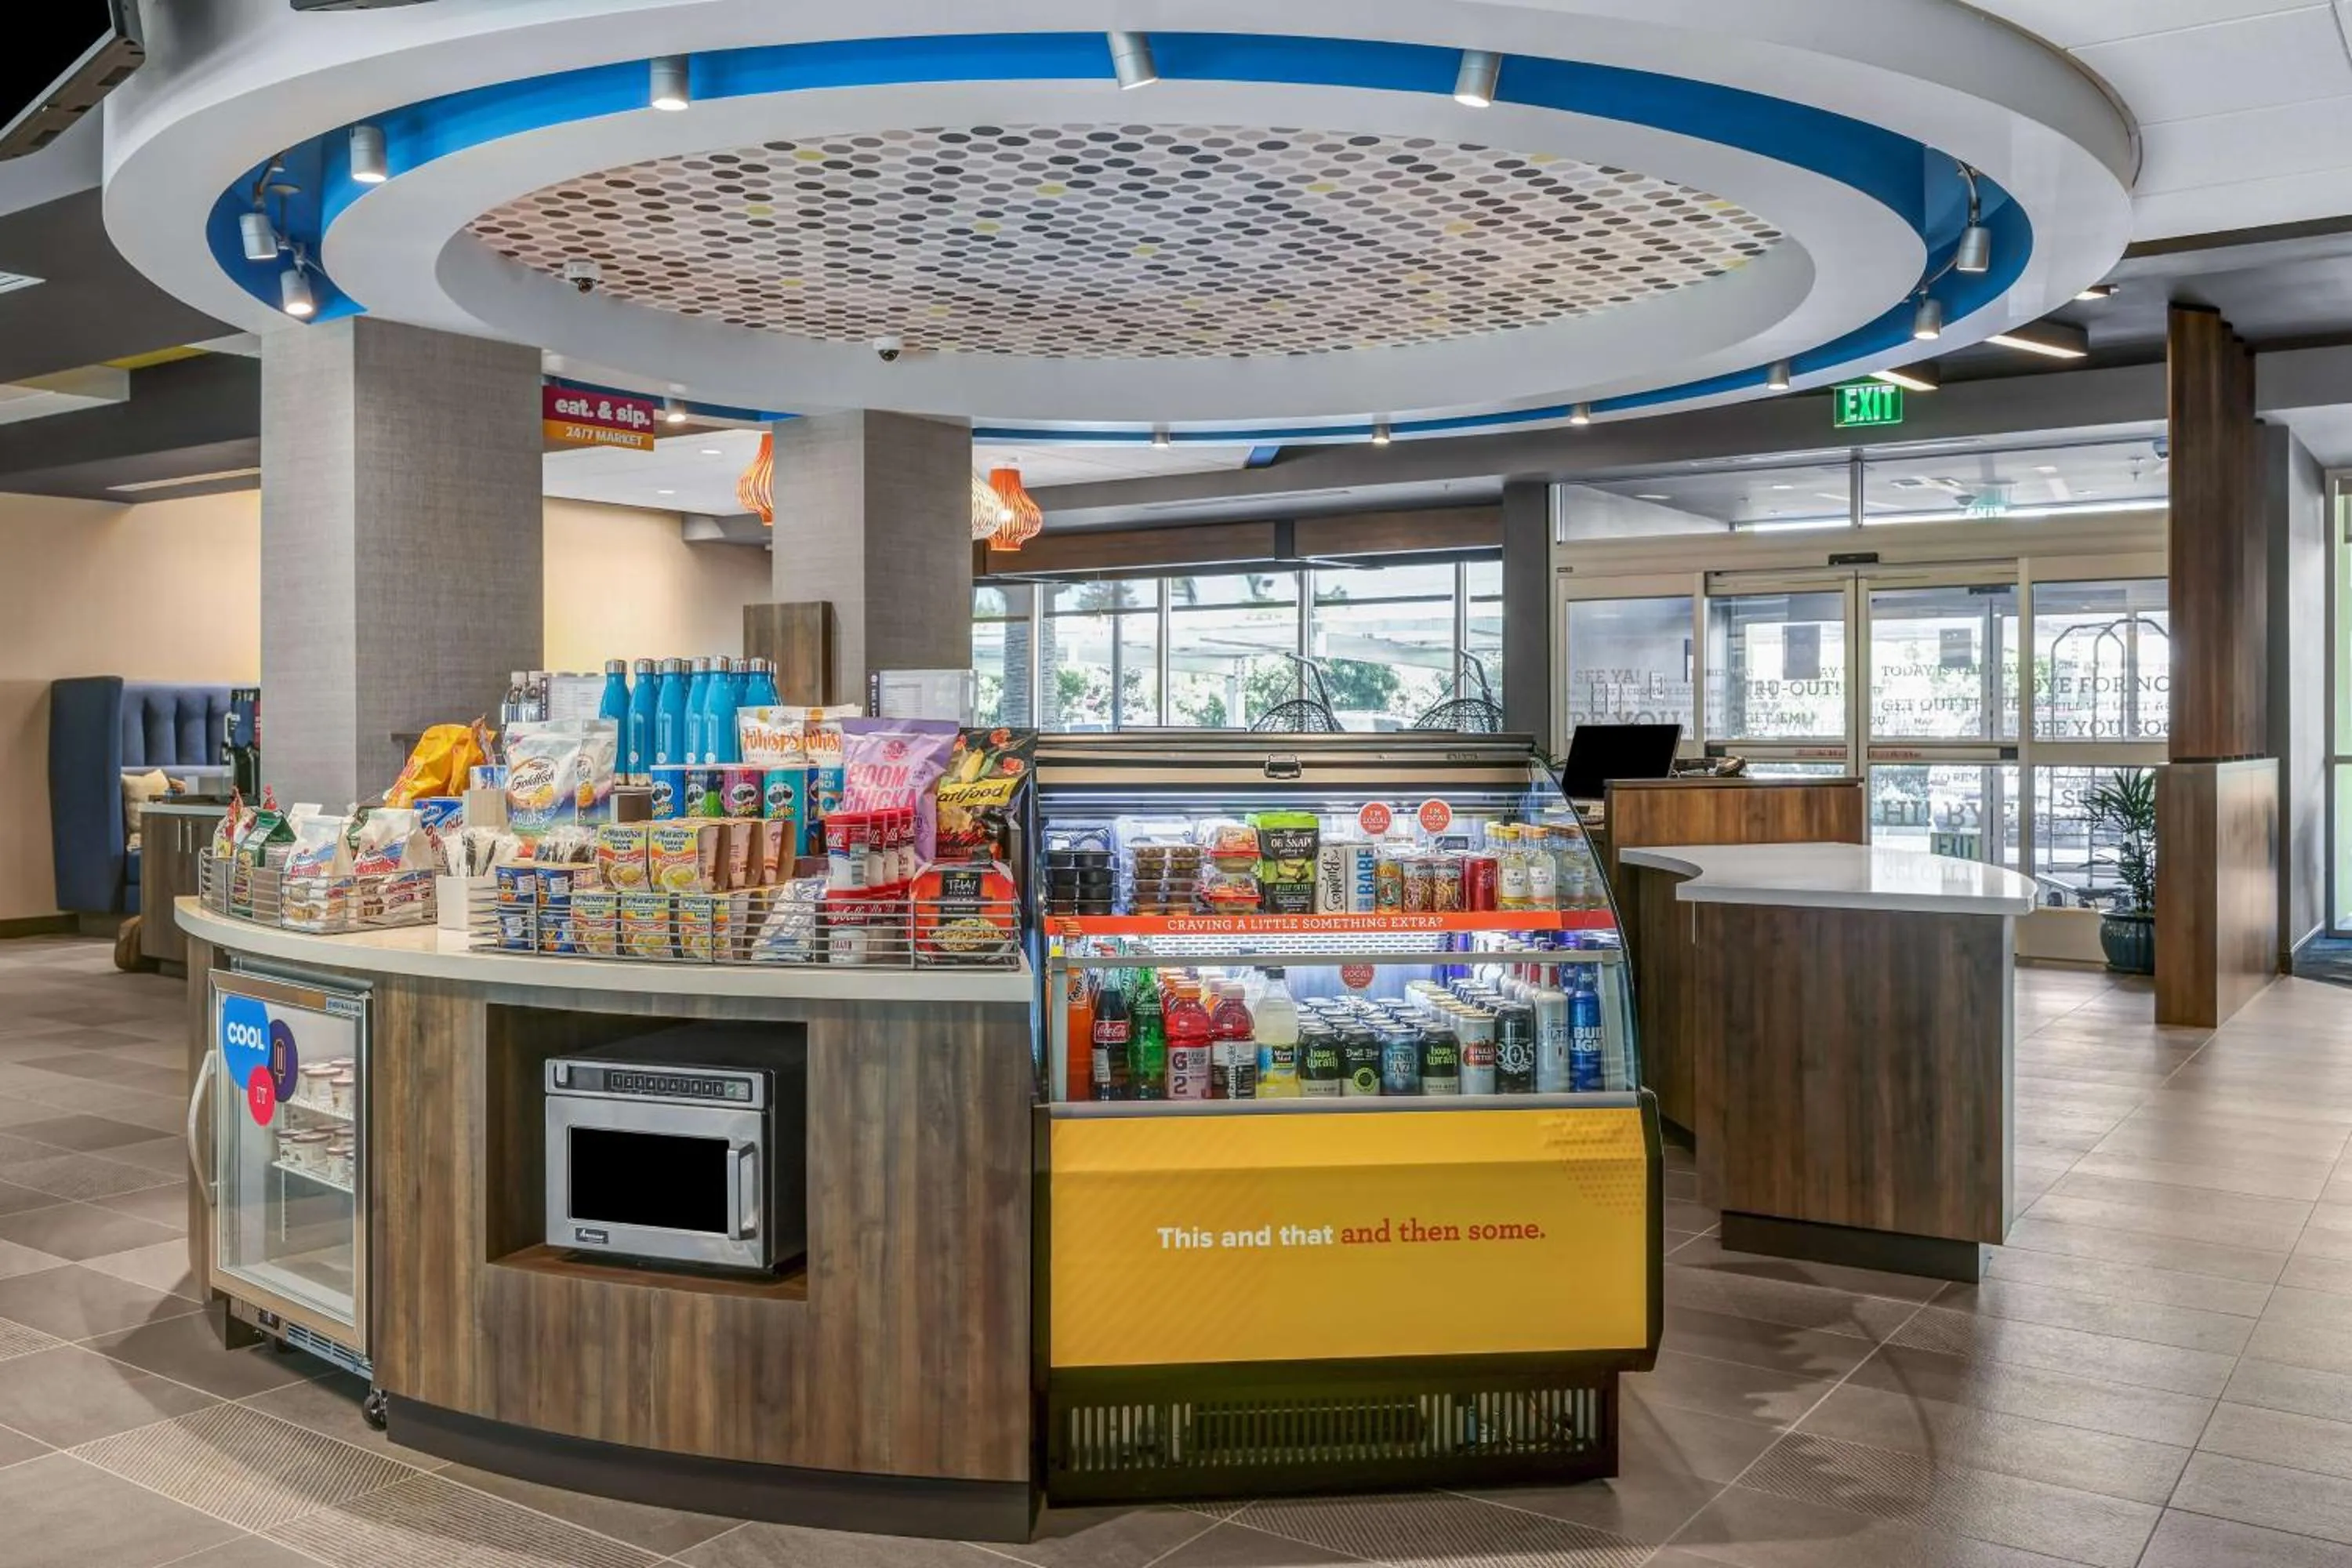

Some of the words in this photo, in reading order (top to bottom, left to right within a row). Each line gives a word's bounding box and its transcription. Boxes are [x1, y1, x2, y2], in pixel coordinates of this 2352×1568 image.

[554, 398, 593, 417] eat.
[597, 401, 612, 420] &
[616, 404, 650, 429] sip.
[1844, 386, 1895, 423] EXIT
[565, 426, 593, 440] 24/7
[595, 430, 643, 446] MARKET
[1574, 670, 1605, 684] SEE
[1882, 665, 1933, 677] TODAY
[2136, 675, 2169, 691] NO
[1167, 920, 1232, 931] CRAVING
[1237, 920, 1247, 930] A
[1250, 919, 1298, 930] LITTLE
[1302, 917, 1387, 929] SOMETHING
[1391, 916, 1443, 928] EXTRA?
[227, 1022, 266, 1051] COOL
[1172, 1051, 1187, 1071] G
[1495, 1043, 1534, 1065] 805
[256, 1085, 267, 1105] IT
[1174, 1076, 1187, 1094] 2
[1157, 1226, 1213, 1250] This
[1221, 1225, 1272, 1248] and
[1279, 1225, 1334, 1247] that
[1341, 1218, 1392, 1244] and
[1398, 1218, 1461, 1243] then
[1468, 1222, 1546, 1241] some.
